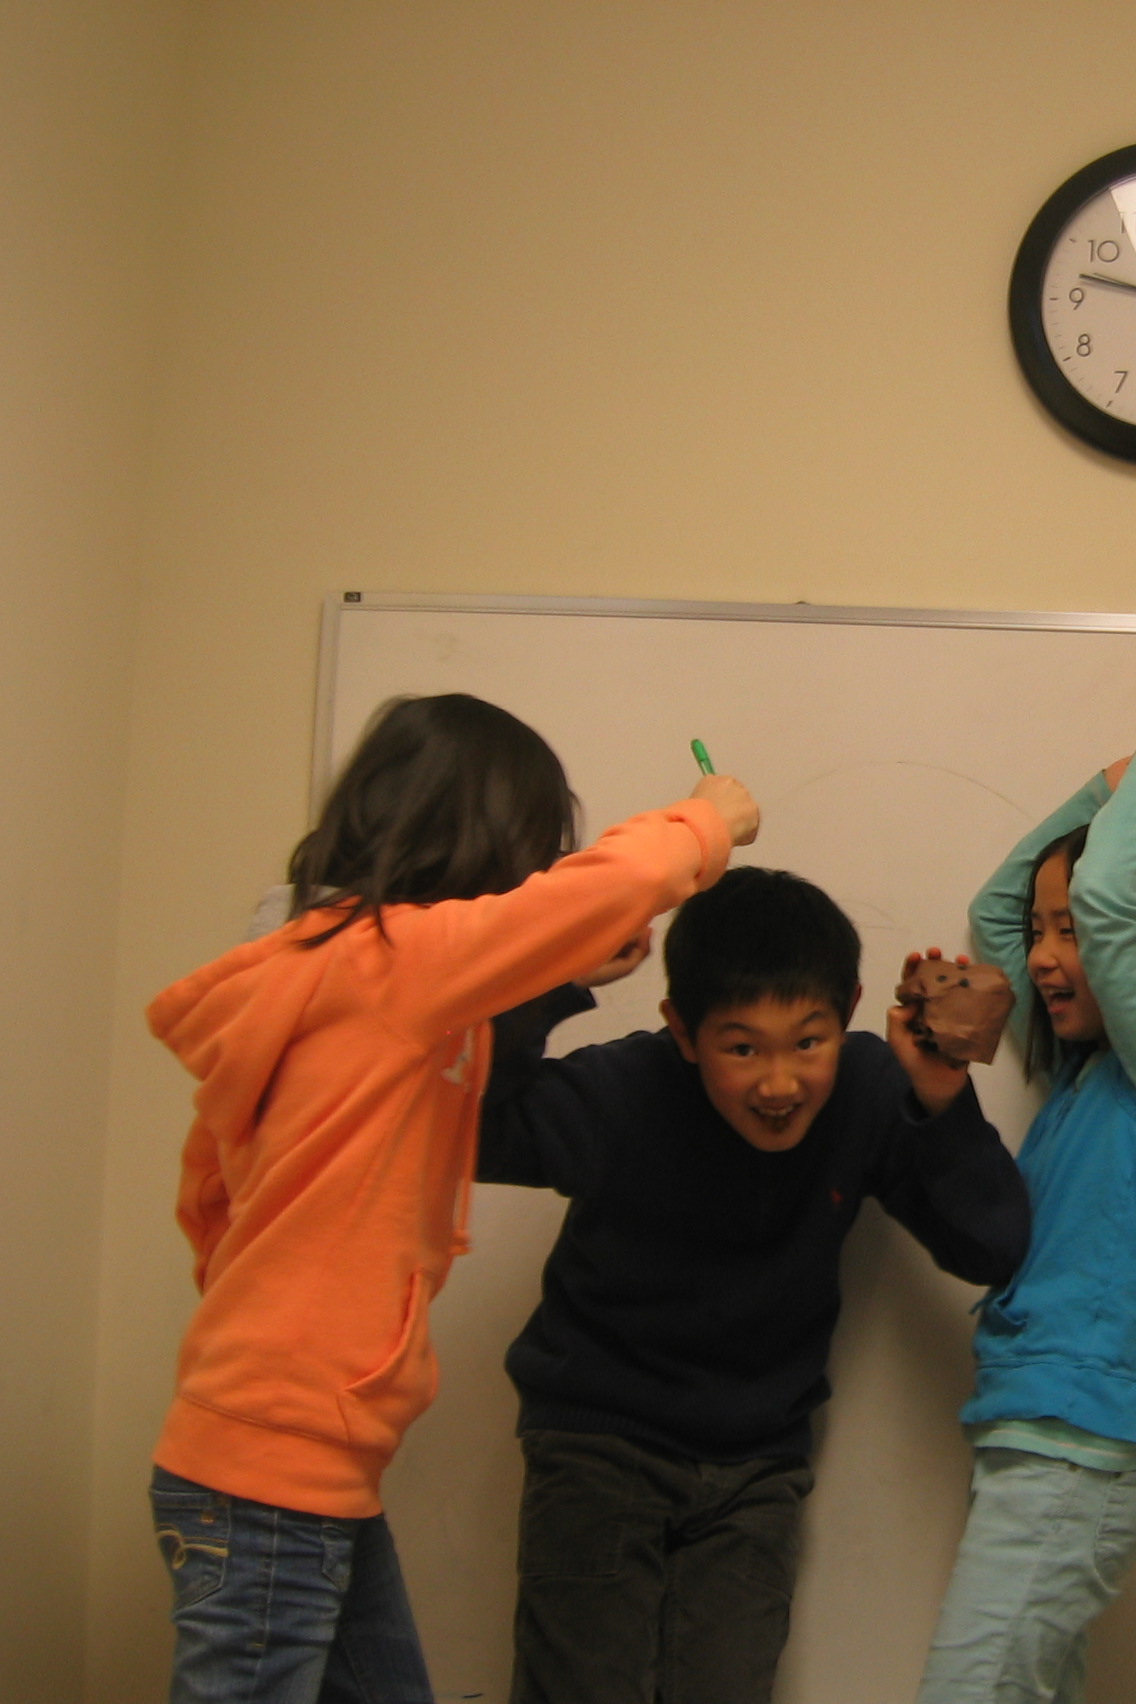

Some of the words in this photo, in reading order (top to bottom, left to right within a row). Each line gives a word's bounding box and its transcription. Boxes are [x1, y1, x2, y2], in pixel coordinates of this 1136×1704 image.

[1087, 239, 1120, 263] 10
[1069, 287, 1085, 310] 9
[1076, 333, 1092, 357] 8
[1114, 370, 1129, 394] 7
